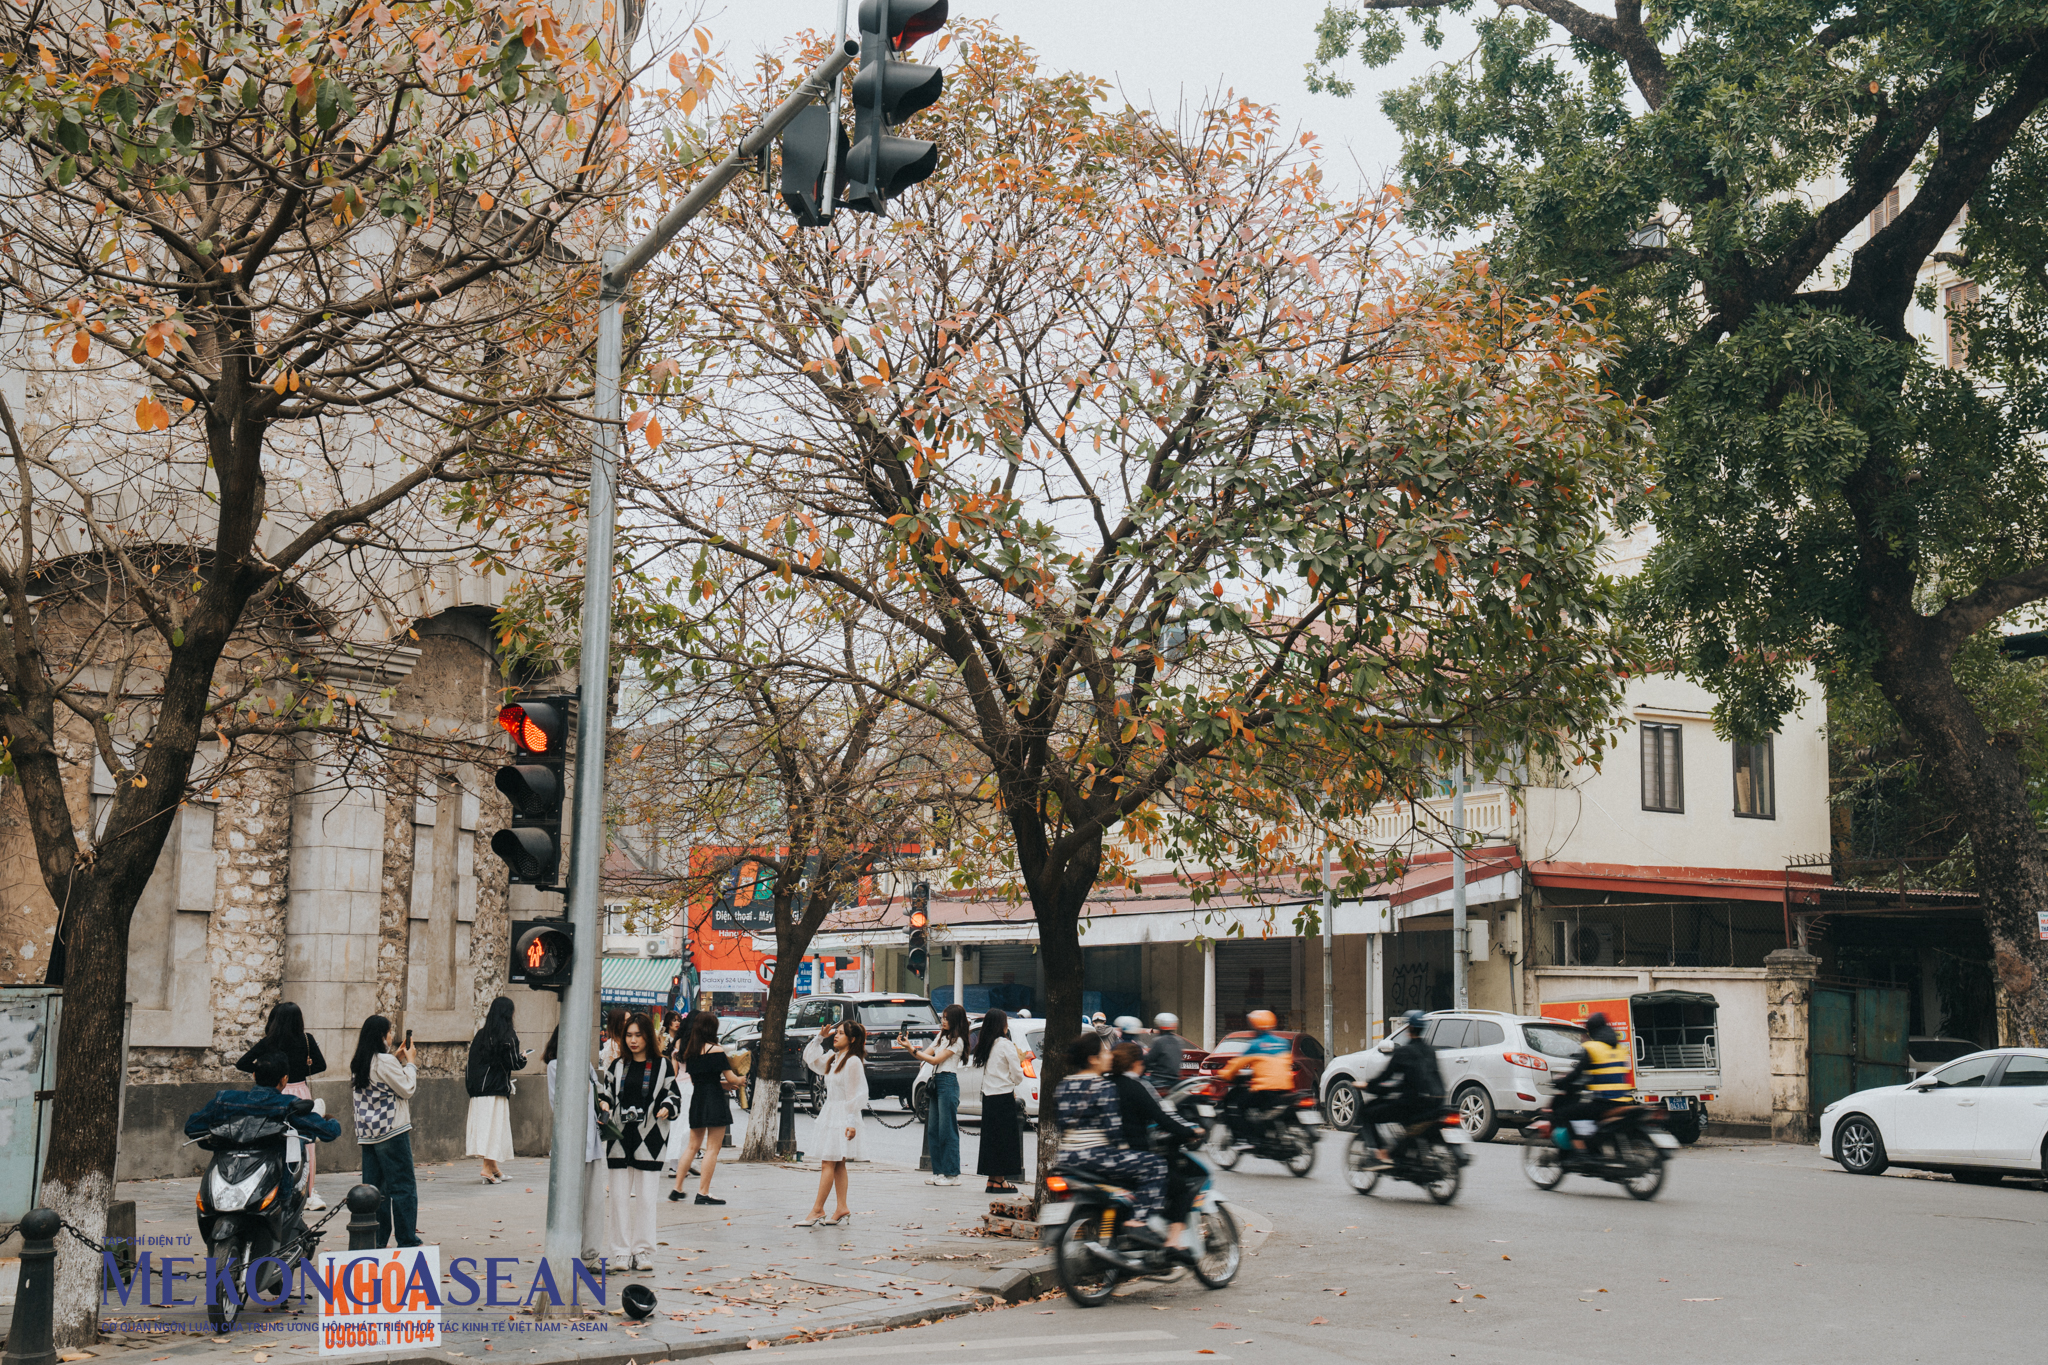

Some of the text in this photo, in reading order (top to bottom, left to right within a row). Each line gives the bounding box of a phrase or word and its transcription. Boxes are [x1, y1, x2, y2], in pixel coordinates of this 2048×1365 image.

[716, 910, 732, 923] Điện
[758, 910, 774, 924] Máy
[325, 1250, 435, 1317] KHÓA
